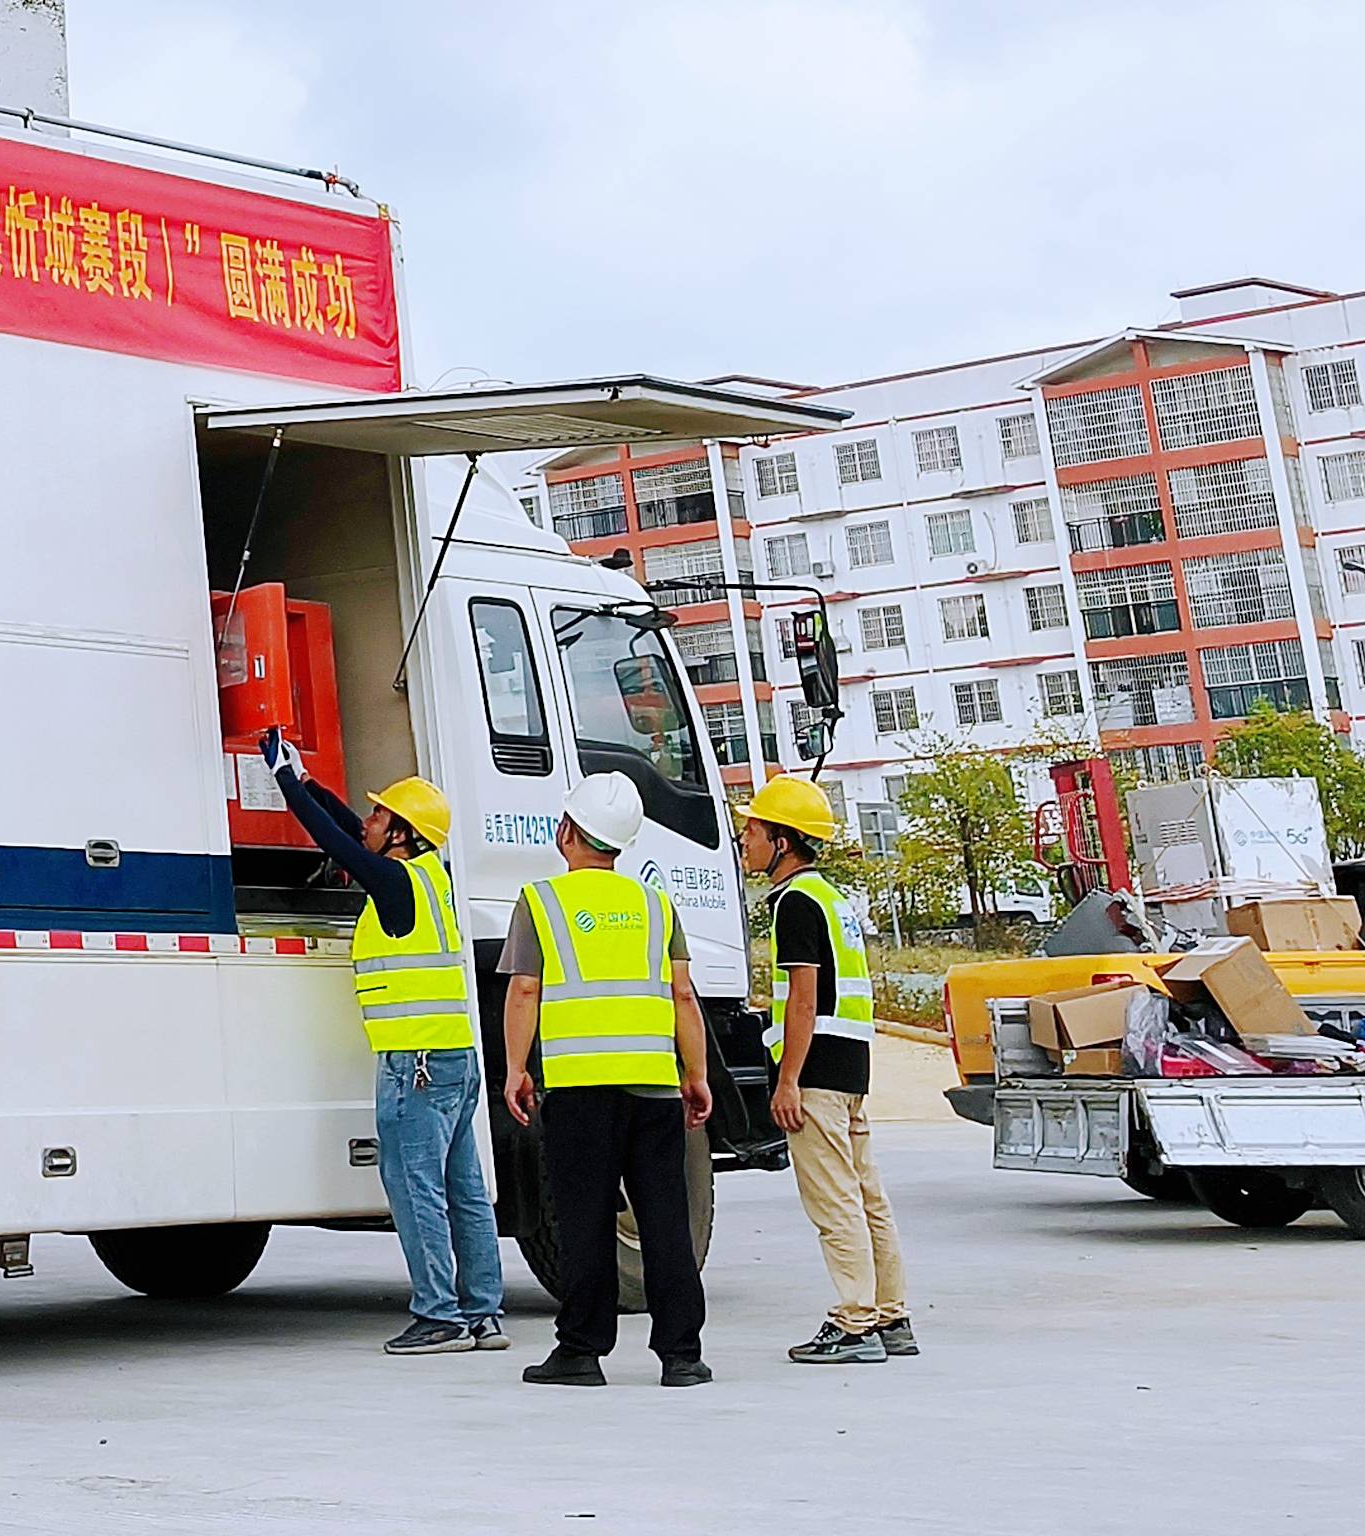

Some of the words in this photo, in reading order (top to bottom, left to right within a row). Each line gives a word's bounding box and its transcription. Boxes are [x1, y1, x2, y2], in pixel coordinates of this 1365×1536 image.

[671, 866, 725, 892] 中国移动
[673, 892, 698, 908] China
[699, 894, 726, 910] Mobile
